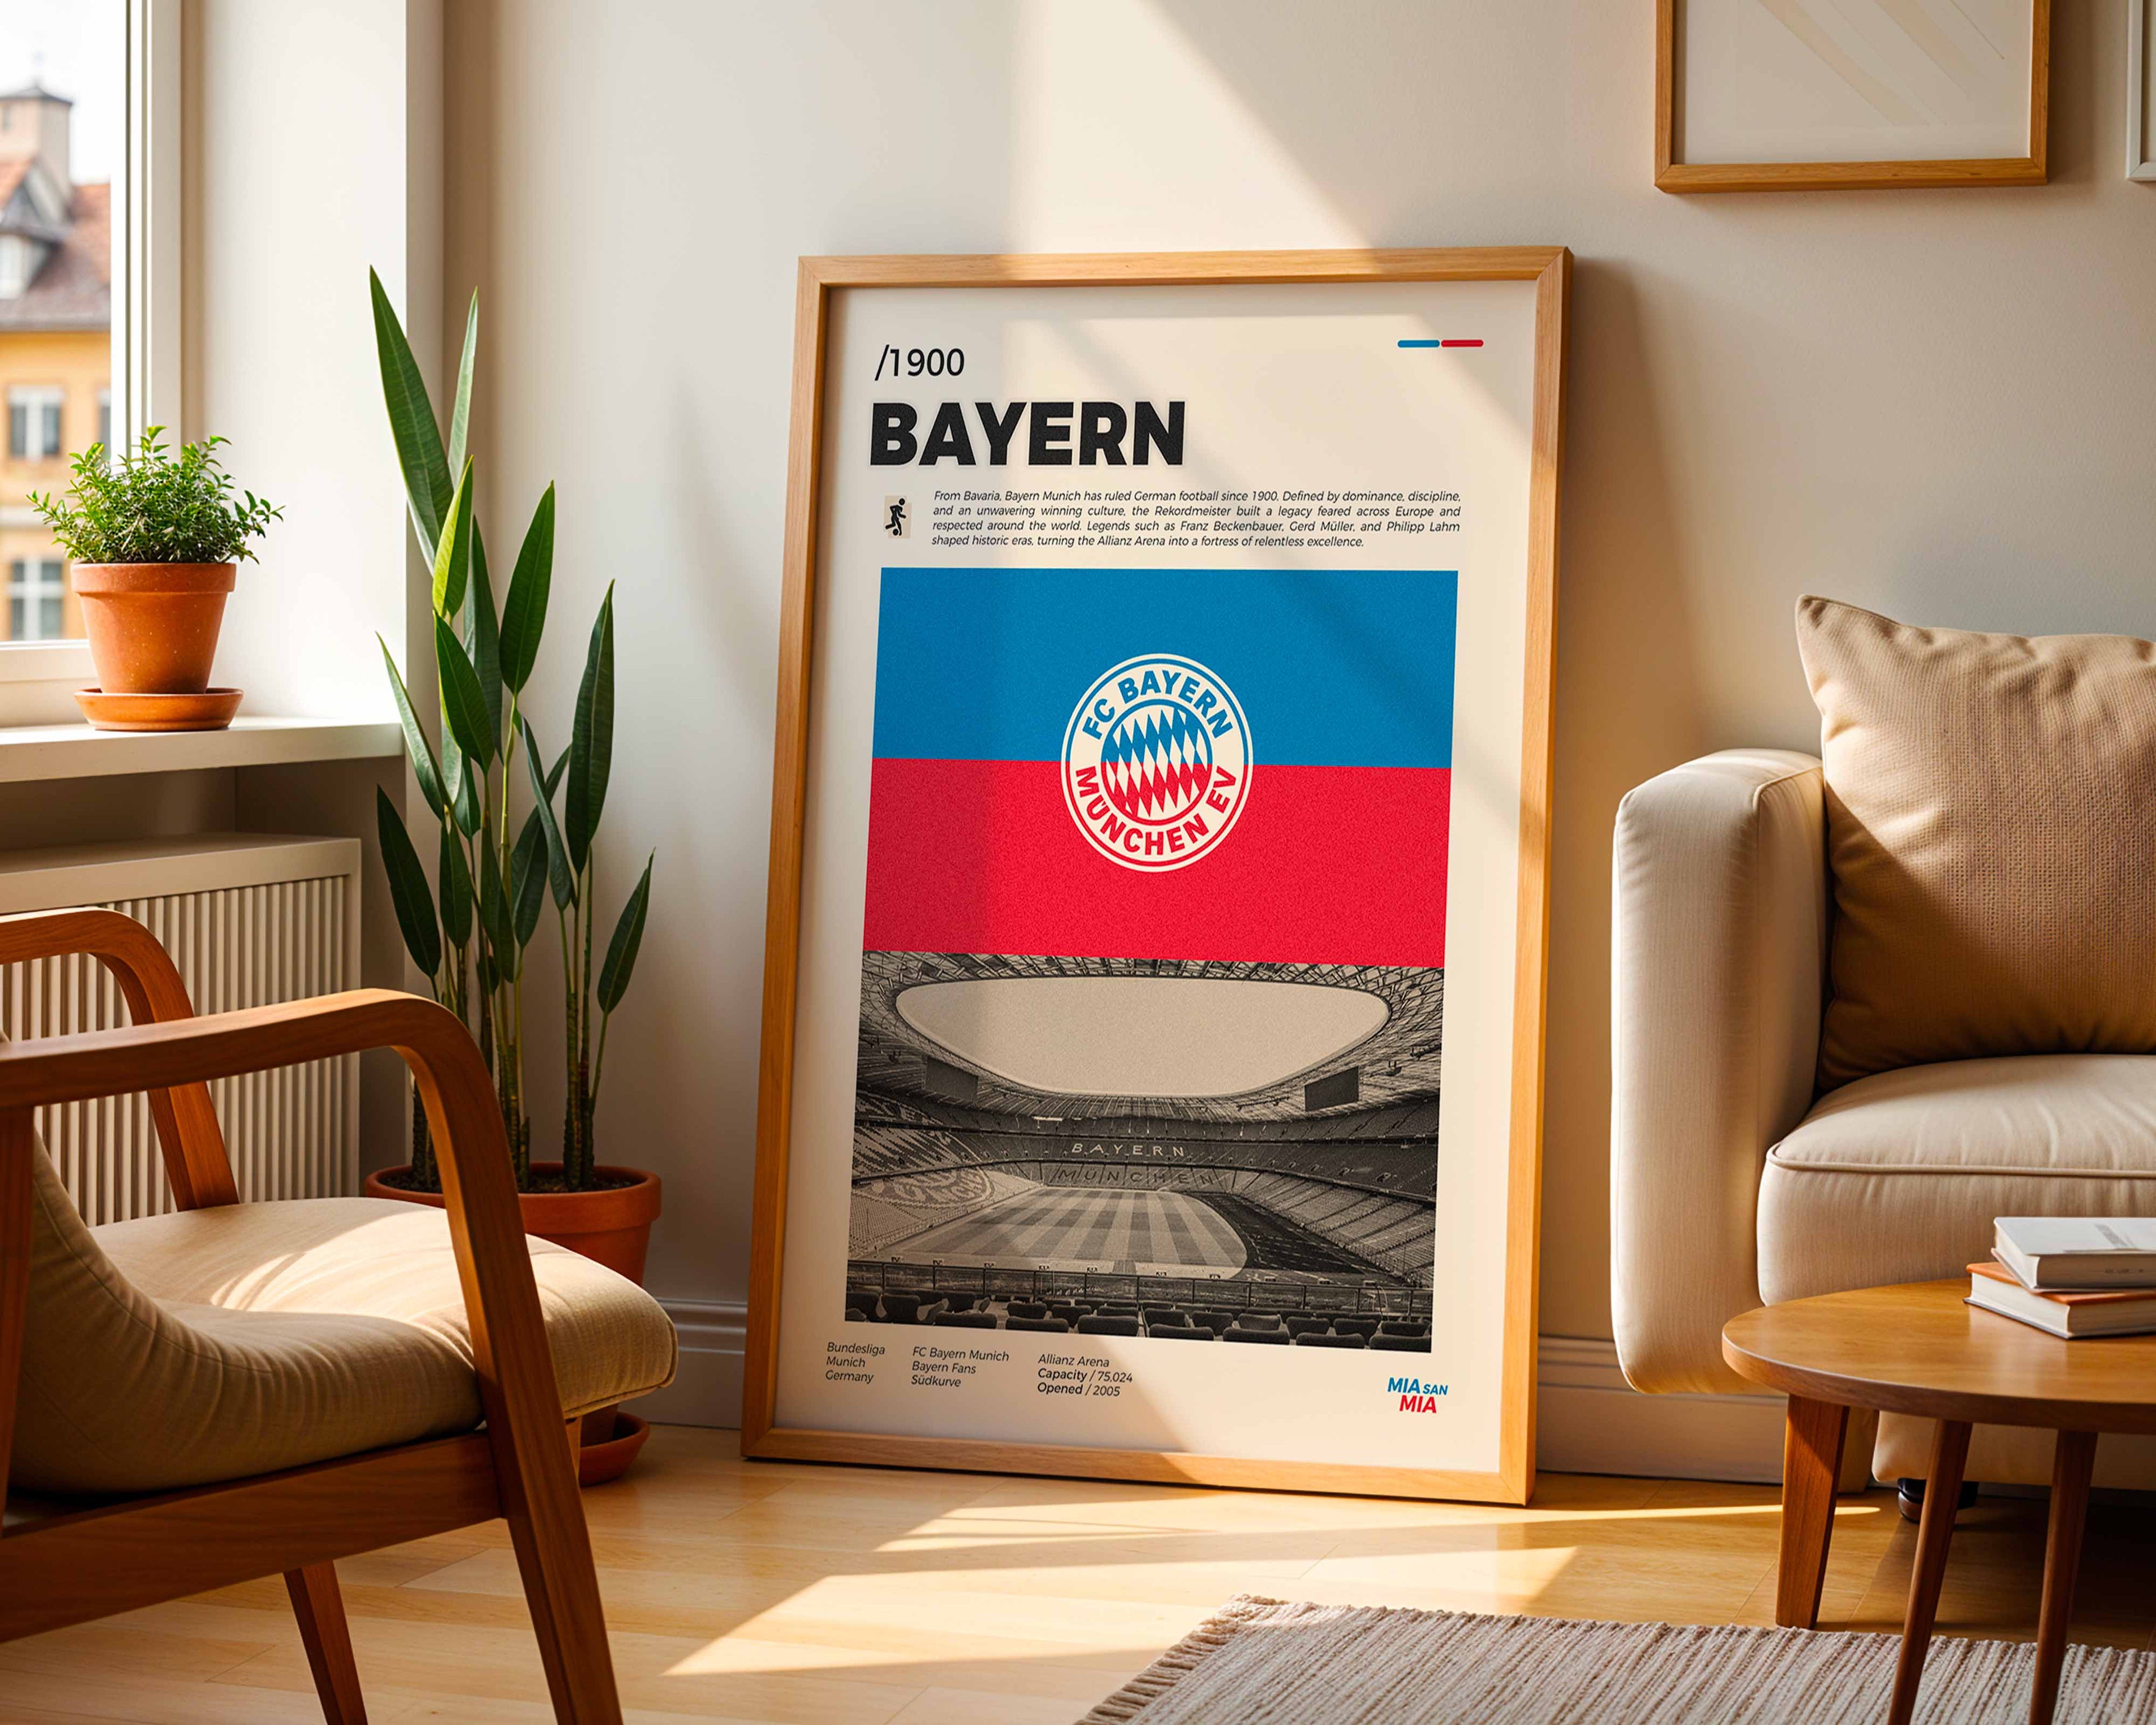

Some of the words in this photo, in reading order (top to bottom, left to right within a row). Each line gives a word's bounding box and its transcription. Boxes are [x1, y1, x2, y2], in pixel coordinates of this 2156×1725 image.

[874, 344, 965, 381] /1900
[870, 401, 1185, 466] BAYERN
[934, 490, 960, 501] From
[1005, 490, 1040, 503] Bayern
[1043, 491, 1081, 501] Munich
[1084, 491, 1102, 501] has
[1104, 491, 1132, 501] ruled
[1134, 491, 1176, 501] German
[1178, 491, 1219, 501] football
[1221, 491, 1248, 501] since
[1253, 491, 1279, 502] 1900.
[1283, 491, 1324, 502] Defined
[1327, 491, 1340, 504] by
[933, 505, 953, 516] and
[958, 508, 971, 516] an
[977, 505, 1035, 518] unwavering
[1040, 506, 1082, 519] winning
[1132, 506, 1149, 517] the
[1155, 506, 1231, 517] Rekordmeister
[1236, 506, 1261, 517] built
[1266, 509, 1272, 517] a
[1277, 506, 1313, 519] legacy
[1317, 506, 1352, 517] feared
[1356, 509, 1390, 517] across
[1395, 506, 1435, 519] Europe
[1440, 506, 1461, 517] and
[933, 520, 983, 533] respected
[987, 520, 1025, 531] around
[1029, 521, 1047, 531] the
[1051, 521, 1082, 531] world.
[1087, 521, 1131, 533] Legends
[1134, 521, 1159, 531] such
[1164, 523, 1176, 531] as
[1180, 521, 1208, 531] Franz
[1290, 521, 1315, 532] Gerd
[1360, 521, 1381, 532] and
[1386, 521, 1424, 534] Philipp
[1429, 521, 1460, 532] Lahm
[931, 535, 970, 548] shaped
[972, 535, 1009, 546] historic
[1037, 536, 1075, 549] turning
[1078, 536, 1095, 546] the
[1097, 536, 1132, 546] Allianz
[1134, 536, 1166, 546] Arena
[1168, 536, 1189, 546] into
[1191, 538, 1198, 546] a
[1201, 536, 1239, 546] fortress
[1241, 536, 1253, 546] of
[1255, 536, 1304, 547] relentless
[1307, 536, 1364, 547] excellence.
[1082, 699, 1116, 740] FC
[1117, 670, 1234, 739] BAYERN
[1205, 765, 1237, 814] EV
[1071, 1143, 1185, 1157] BAYERN
[1058, 1168, 1213, 1185] MÜNCHEN
[826, 1341, 885, 1357] Bundesliga
[912, 1346, 927, 1357] FC
[930, 1347, 966, 1361] Bayern
[969, 1350, 1009, 1361] Munich
[826, 1356, 866, 1368] Munich
[912, 1361, 948, 1373] Bayern
[952, 1363, 976, 1374] Fans
[1038, 1354, 1075, 1366] Allianz
[1077, 1356, 1110, 1367] Arena
[825, 1370, 874, 1384] Germany
[911, 1374, 961, 1388] Südkurve
[1038, 1368, 1088, 1382] Capacity
[1089, 1370, 1096, 1382] /
[1037, 1382, 1084, 1395] Opened
[1085, 1384, 1092, 1397] /
[1093, 1385, 1121, 1397] 2005
[1387, 1377, 1420, 1394] MIA
[1423, 1384, 1448, 1395] SAN
[1399, 1394, 1437, 1413] MIA
